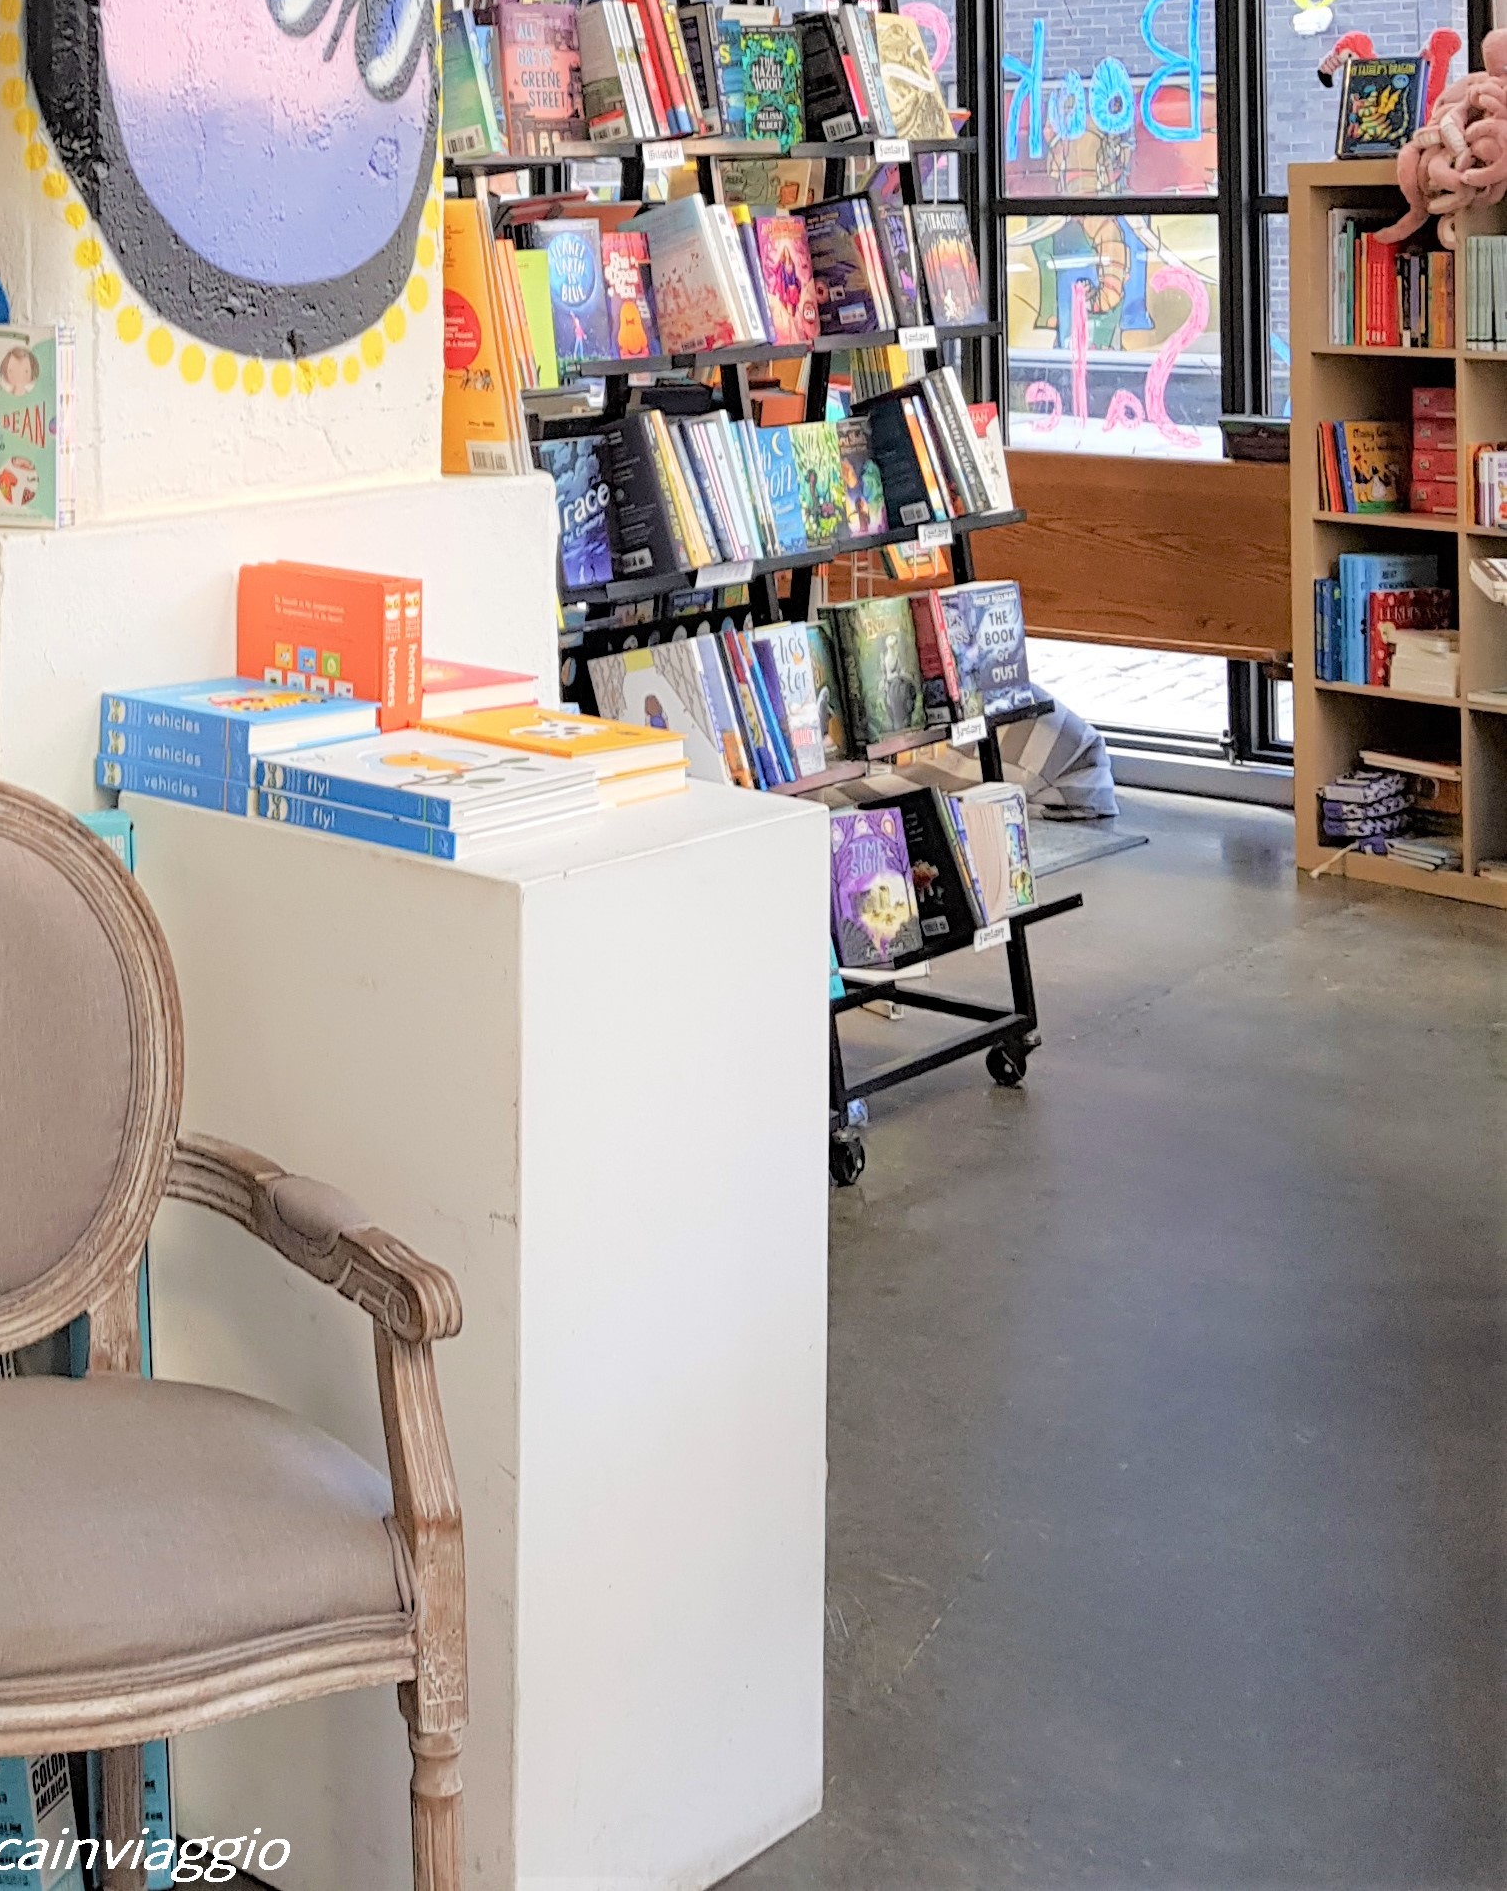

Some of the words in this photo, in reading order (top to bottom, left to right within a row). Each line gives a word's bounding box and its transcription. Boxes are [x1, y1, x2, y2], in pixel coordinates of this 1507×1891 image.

[759, 57, 775, 66] THE
[521, 71, 561, 88] GREENE
[752, 64, 783, 80] HAZEL
[753, 78, 783, 92] WOOD
[529, 91, 566, 108] STREET
[551, 239, 585, 259] PLANET
[568, 272, 577, 285] IS
[561, 286, 587, 303] BLUE
[3, 400, 46, 448] BEAN
[988, 610, 1009, 627] THE
[985, 627, 1016, 646] BOOK
[386, 646, 399, 709] homes
[407, 642, 419, 706] homes
[993, 665, 1020, 681] DUST
[146, 710, 201, 735] vehicles
[147, 744, 201, 769] vehicles
[142, 774, 199, 799] vehicles
[306, 776, 331, 798] fly!
[311, 808, 337, 830] fly!
[849, 841, 884, 859] TIME
[850, 857, 886, 878] SIGHT
[36, 1772, 70, 1816] AMERICA
